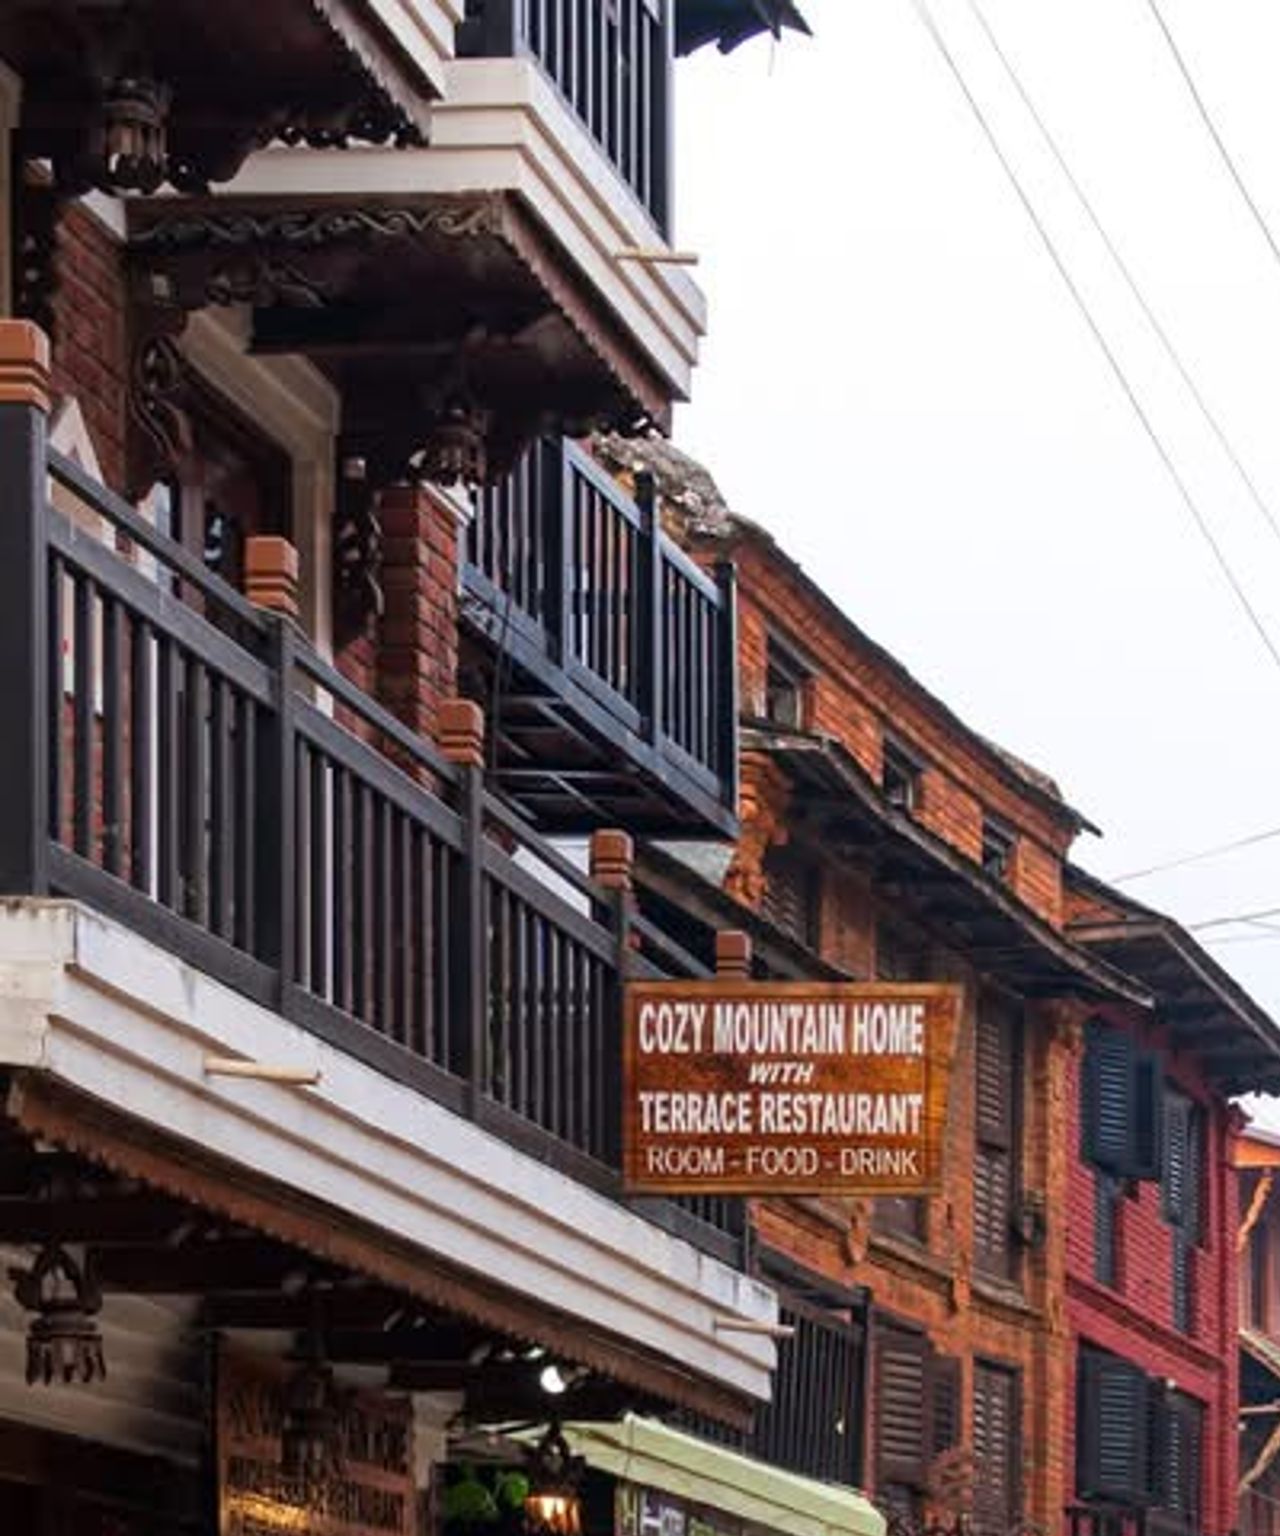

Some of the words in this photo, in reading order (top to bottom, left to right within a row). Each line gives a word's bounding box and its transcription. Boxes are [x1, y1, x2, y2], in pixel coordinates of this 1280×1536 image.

[639, 1003, 705, 1054] COZY
[713, 1003, 845, 1054] MOUNTAIN
[852, 1003, 924, 1056] HOME
[749, 1061, 814, 1084] WITH
[639, 1091, 751, 1134] TERRACE
[760, 1093, 923, 1135] RESTAURANT
[647, 1148, 725, 1175] ROOM
[749, 1148, 819, 1175] FOOD
[840, 1148, 919, 1175] DRINK
